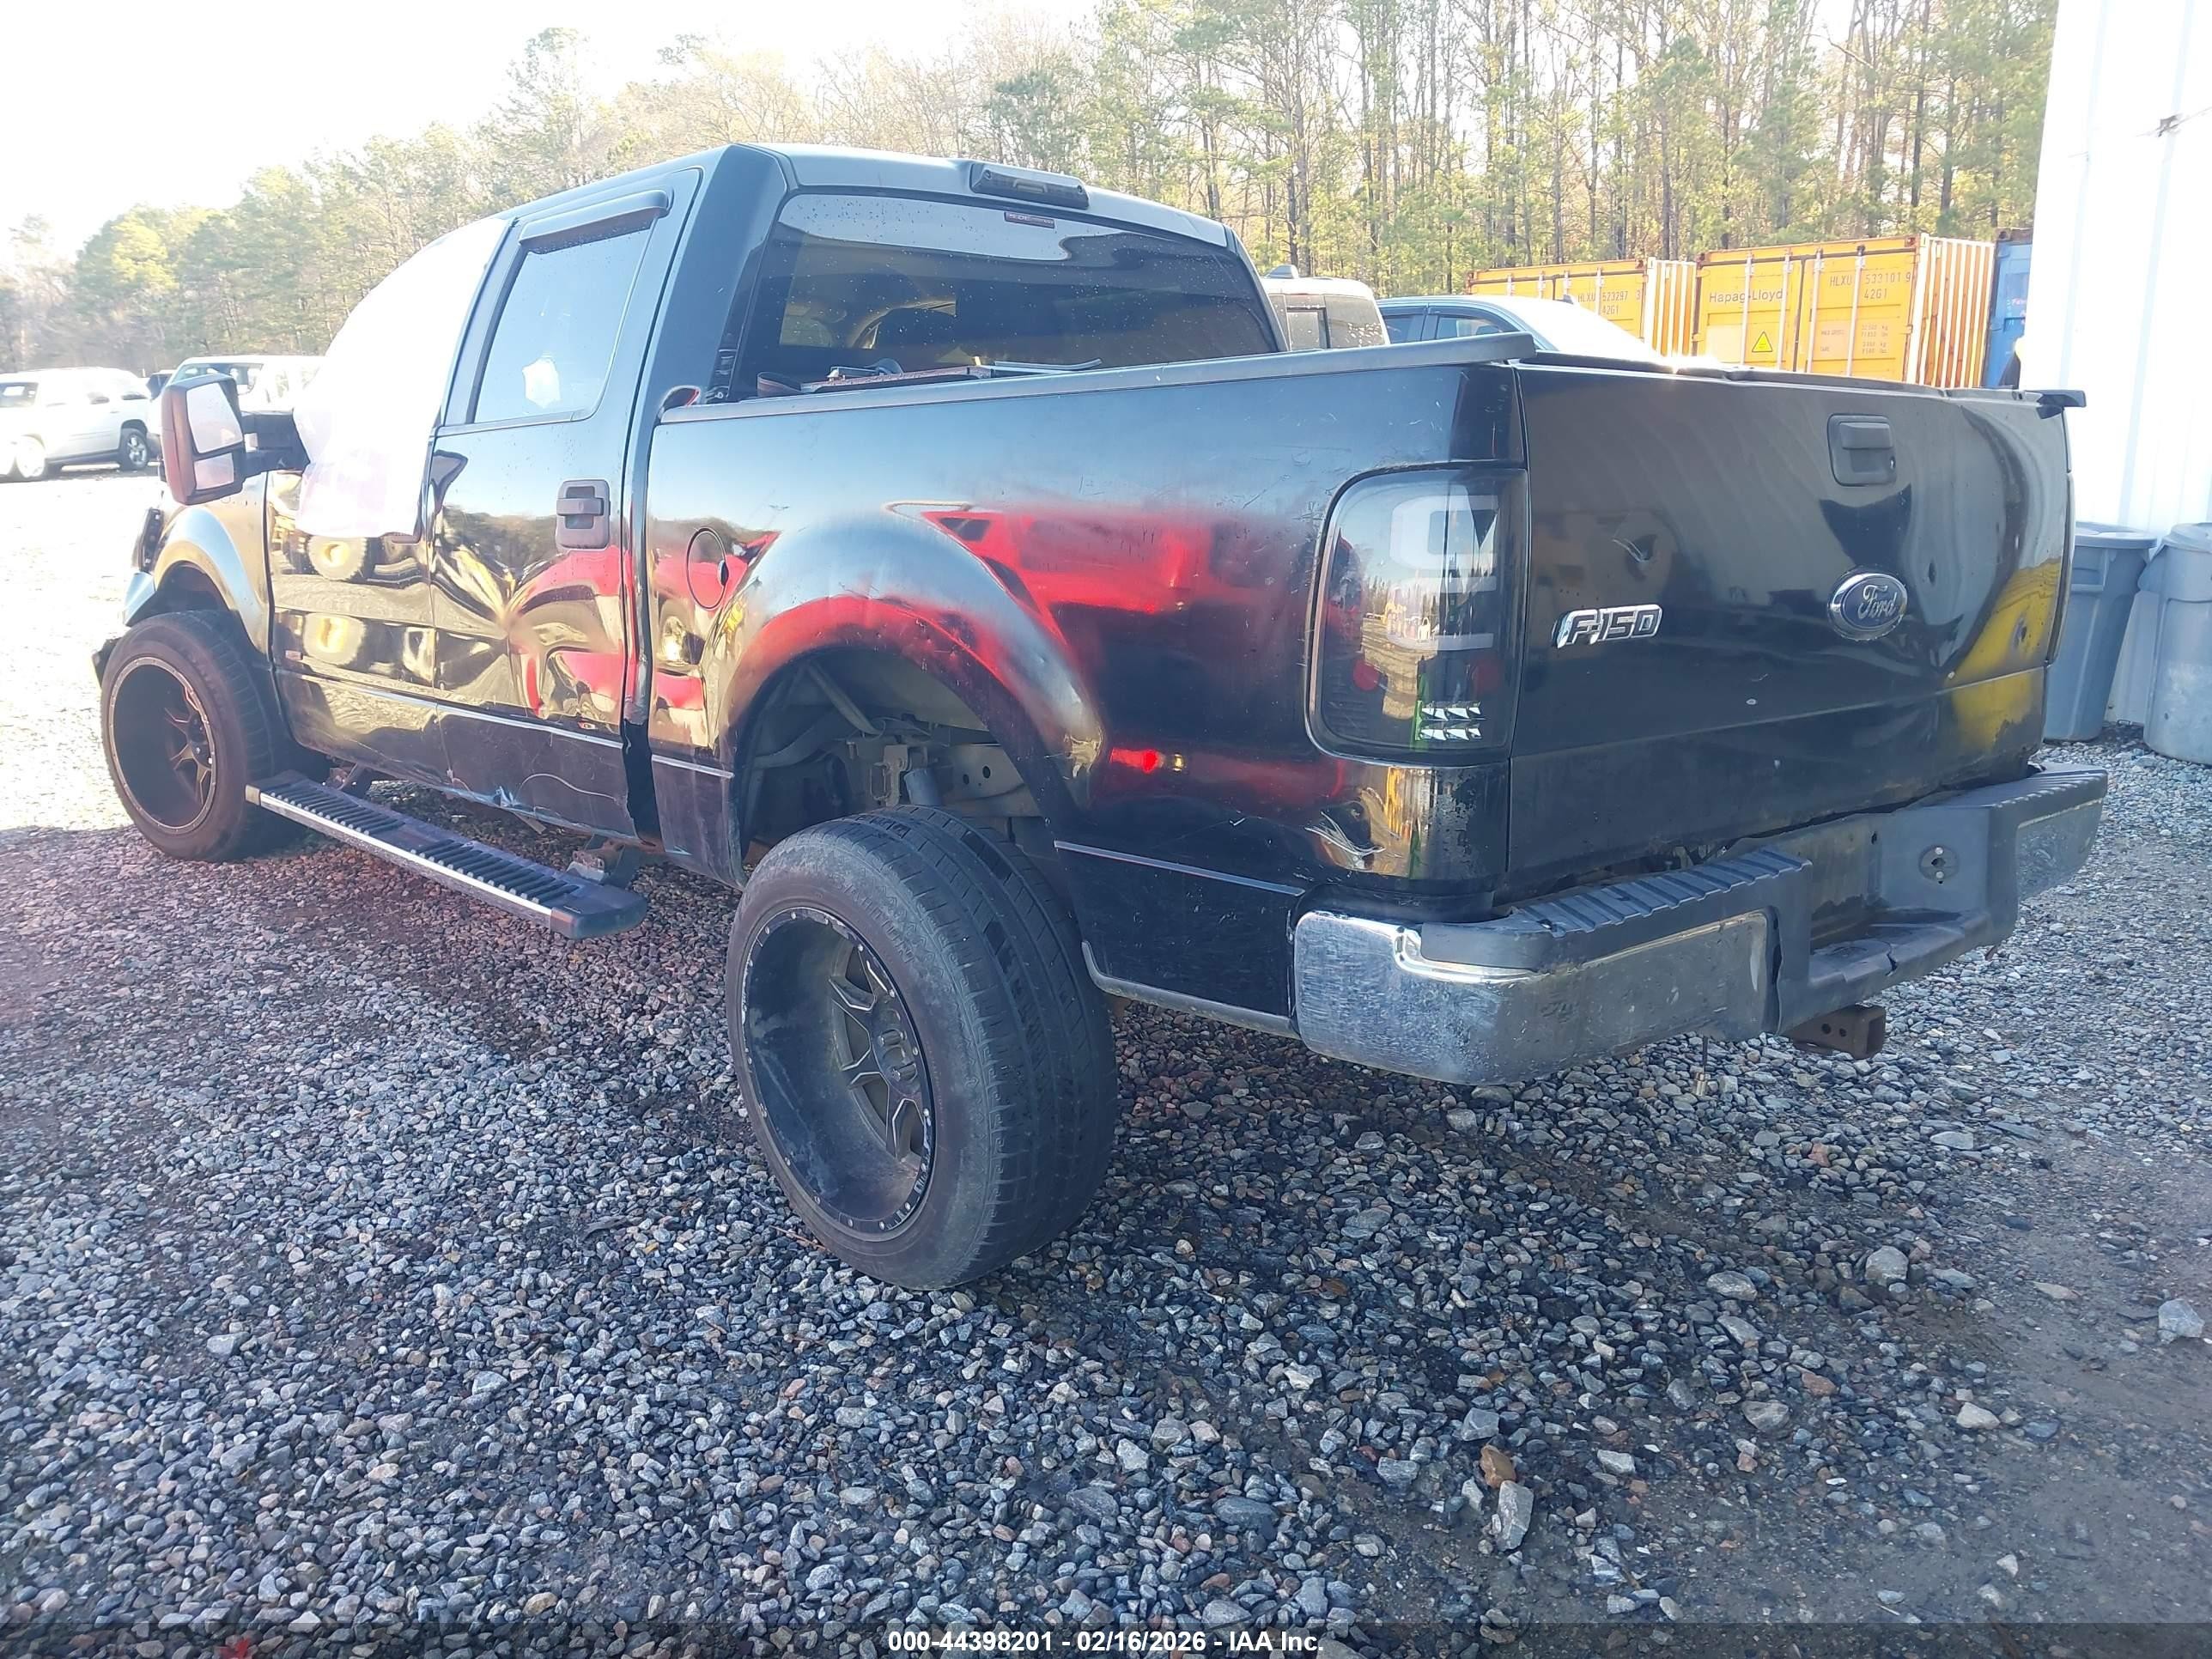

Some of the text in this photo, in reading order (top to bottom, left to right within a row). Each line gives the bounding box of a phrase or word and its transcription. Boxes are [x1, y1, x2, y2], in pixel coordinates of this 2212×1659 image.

[1829, 271, 1911, 287] HLXU 533101 9
[1577, 291, 1596, 302] HLXU
[1709, 289, 1784, 304] Hapag-Lloyd
[1863, 288, 1887, 300] 42G1
[1857, 584, 1898, 619] Ford
